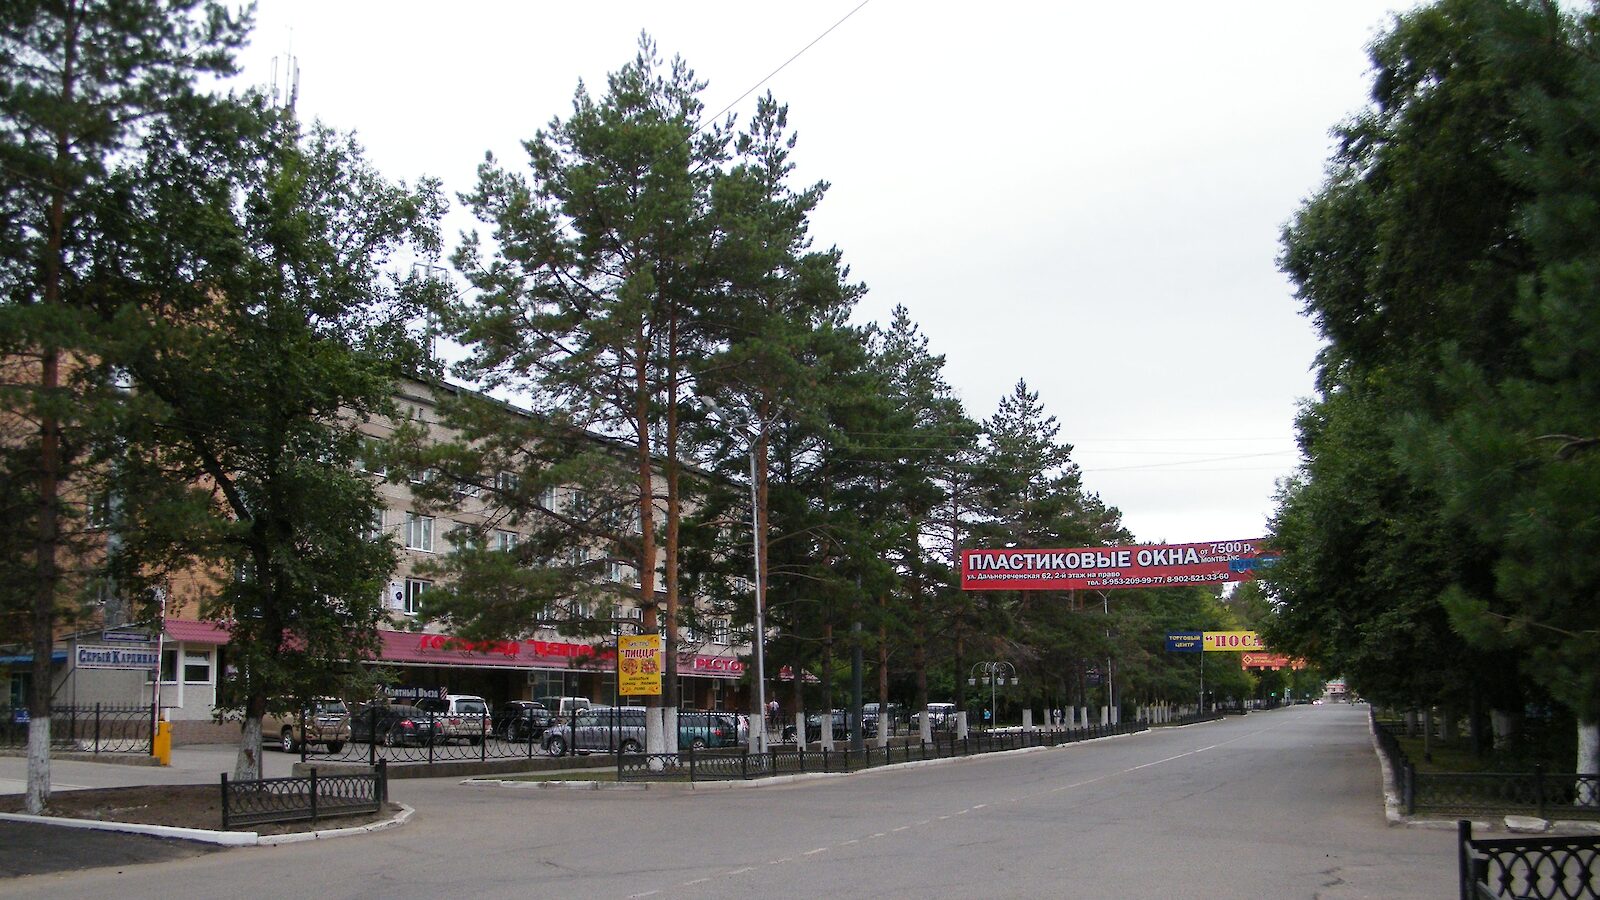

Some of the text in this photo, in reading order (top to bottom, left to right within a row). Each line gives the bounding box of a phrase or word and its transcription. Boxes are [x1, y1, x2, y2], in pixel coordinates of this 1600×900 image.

[1210, 542, 1241, 554] 7500
[1243, 543, 1254, 554] р.
[968, 547, 1199, 570] ПЛАСТИКОВЫЕ ОКНА
[1200, 555, 1240, 563] MONTBLANC
[977, 573, 1040, 581] Дальнереченская
[1041, 572, 1053, 580] 62,
[1097, 571, 1121, 579] право
